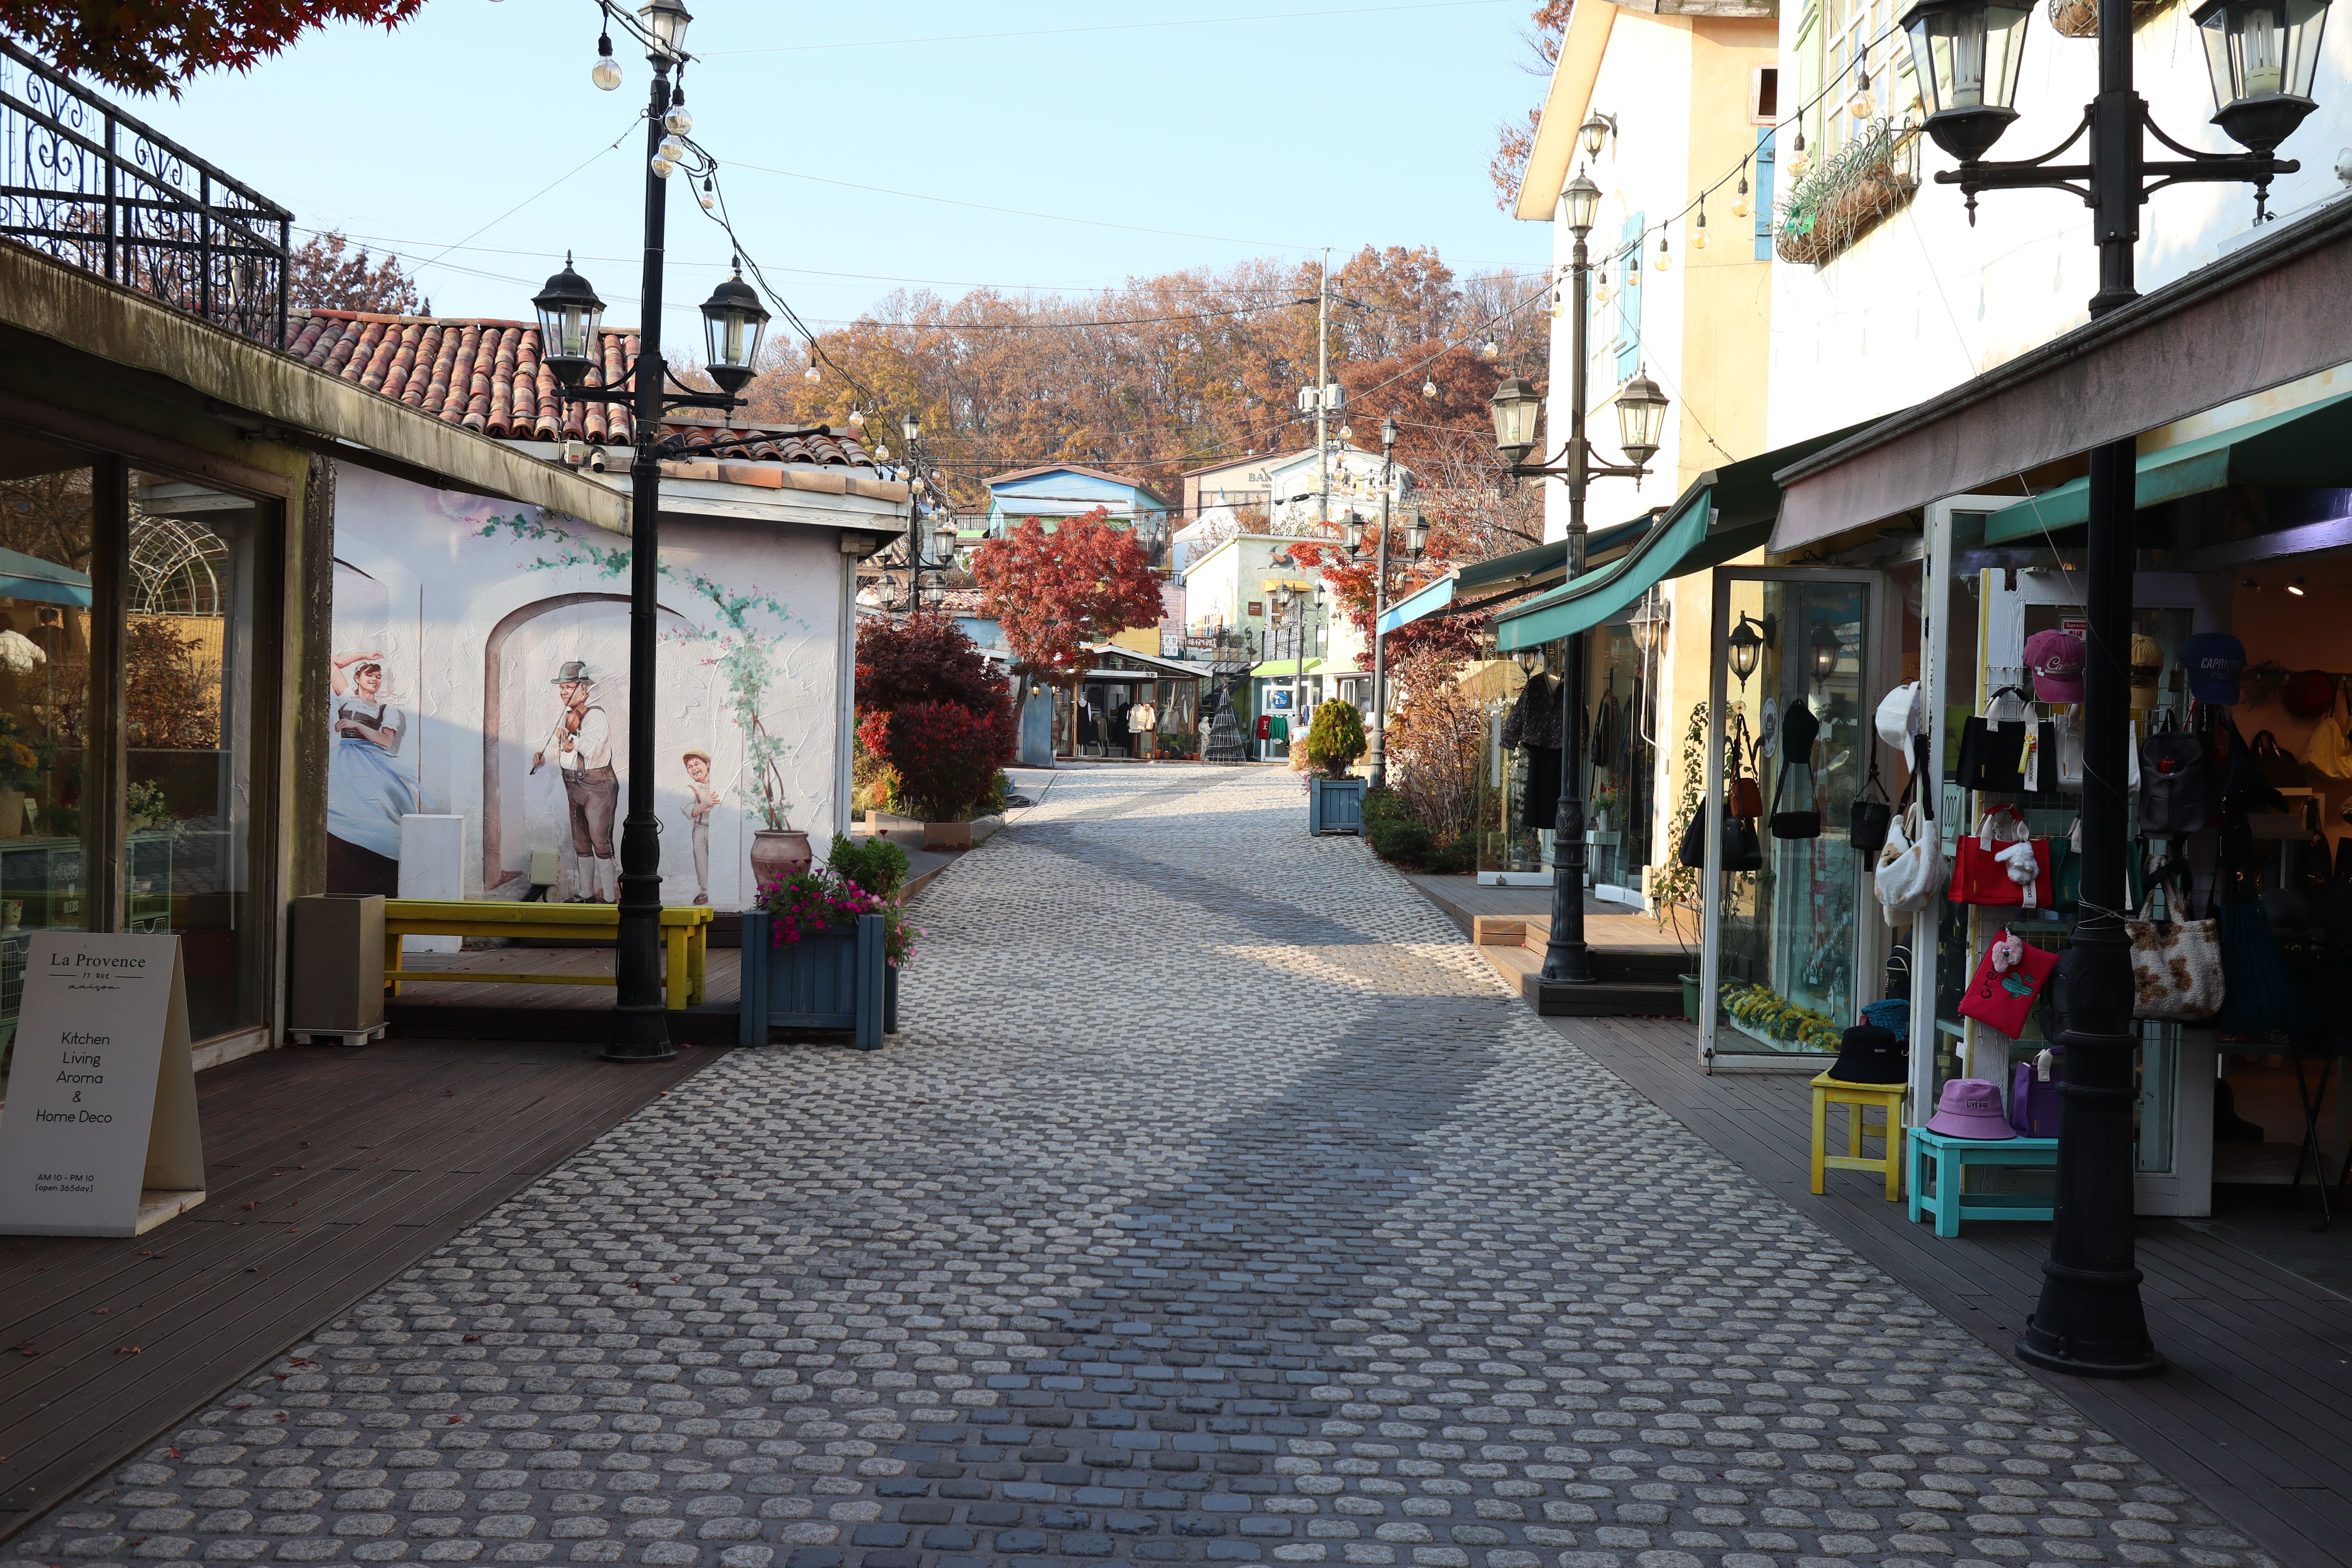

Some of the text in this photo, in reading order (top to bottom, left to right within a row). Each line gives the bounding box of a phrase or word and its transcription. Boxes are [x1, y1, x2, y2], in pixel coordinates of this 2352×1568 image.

[64, 900, 78, 914] BLESS
[51, 953, 145, 968] La Provence
[62, 1032, 110, 1045] Kitchen
[63, 1051, 101, 1067] Living
[56, 1071, 103, 1083] Aroma
[73, 1091, 81, 1103] &
[36, 1109, 112, 1123] Home Deco
[35, 1184, 93, 1193] [open 365day]
